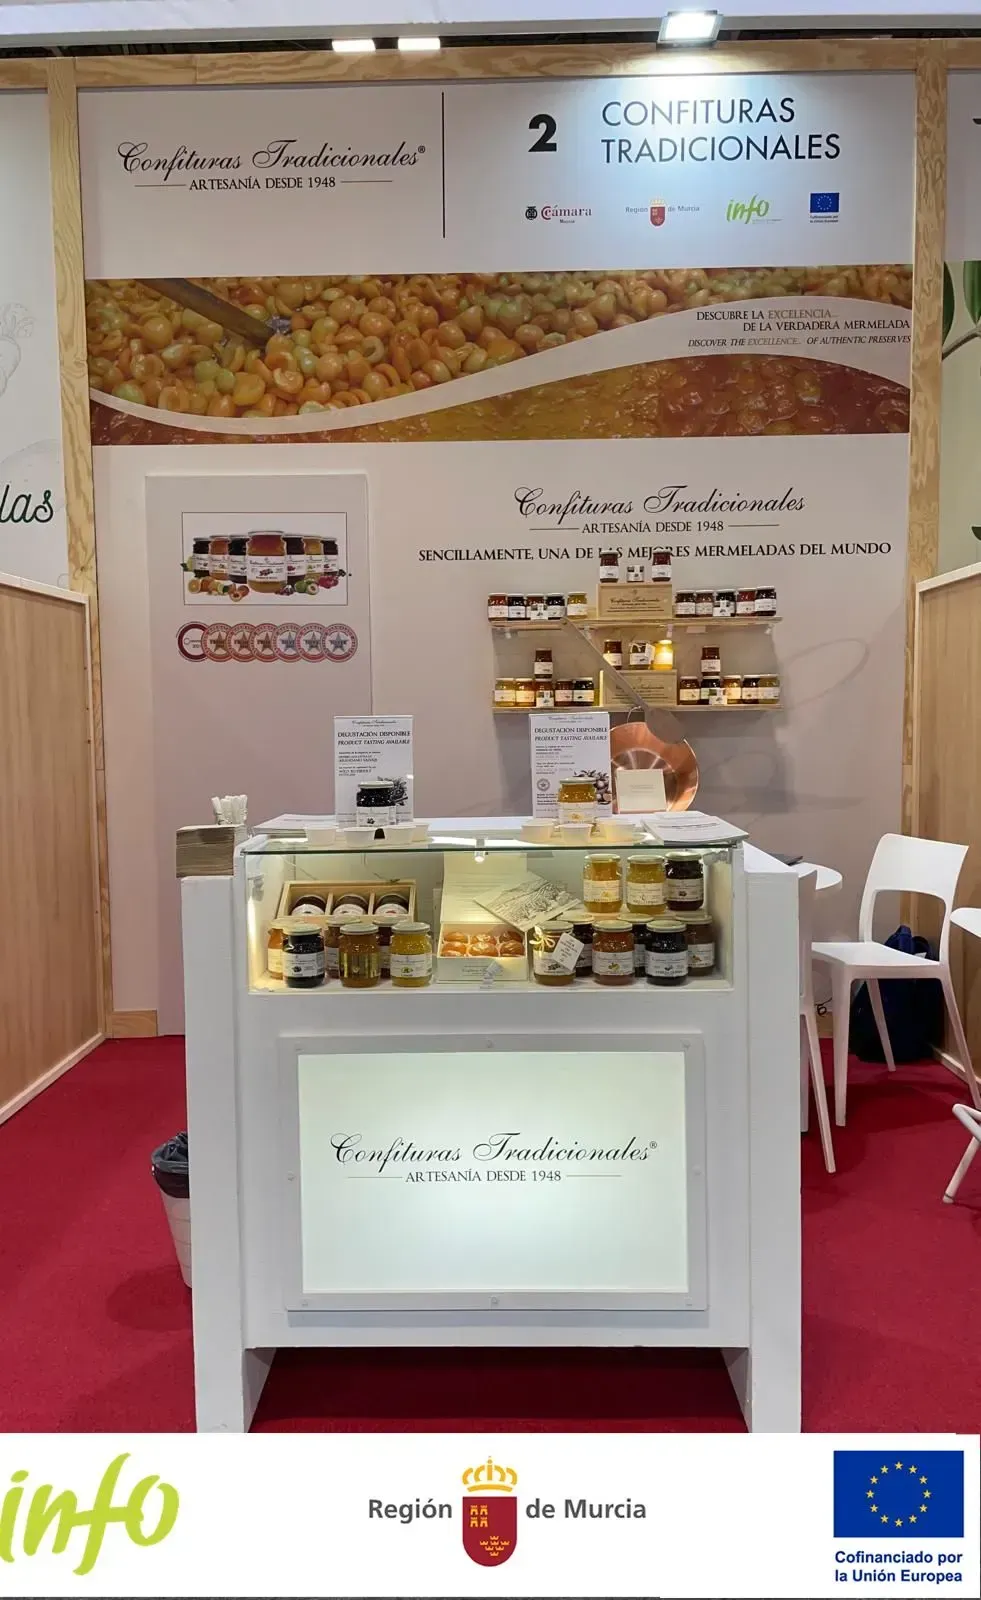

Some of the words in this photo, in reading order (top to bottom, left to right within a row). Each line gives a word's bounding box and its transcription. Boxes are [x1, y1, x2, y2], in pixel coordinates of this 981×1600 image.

[602, 97, 795, 126] CONFITURAS
[528, 113, 557, 153] 2
[601, 133, 841, 163] TRADICIONALES
[117, 141, 243, 181] Confituras
[189, 176, 261, 191] ARTESANÍA
[265, 177, 303, 190] DESDE
[308, 176, 336, 189] 1948
[726, 193, 770, 224] info
[697, 311, 748, 321] DESCUBRE
[752, 310, 764, 320] LA
[743, 322, 756, 332] DE
[759, 322, 772, 332] LA
[776, 321, 840, 331] VERDADERA
[844, 320, 910, 330] MERMELADA
[688, 338, 727, 347] DISCOVER
[730, 338, 745, 346] THE
[806, 336, 818, 345] OF
[819, 336, 867, 345] AUTHENTIC
[868, 335, 911, 344] PRESERVES
[514, 486, 634, 524] Confituras
[643, 485, 806, 513] Tradicionales
[582, 520, 651, 533] ARTESANÍA
[655, 521, 692, 532] DESDE
[697, 520, 724, 531] 1948
[418, 549, 534, 561] SENCILLAMENTE,
[538, 548, 568, 559] UNA
[575, 547, 593, 559] DE
[695, 544, 795, 557] MERMELADAS
[800, 543, 826, 555] DEL
[830, 542, 891, 555] MUNDO
[337, 730, 378, 738] DEGUSTACIÓN
[330, 1132, 462, 1174] Confituras
[405, 1169, 481, 1183] ARTESANÍA
[486, 1170, 527, 1182] DESDE
[532, 1170, 562, 1182] 1948
